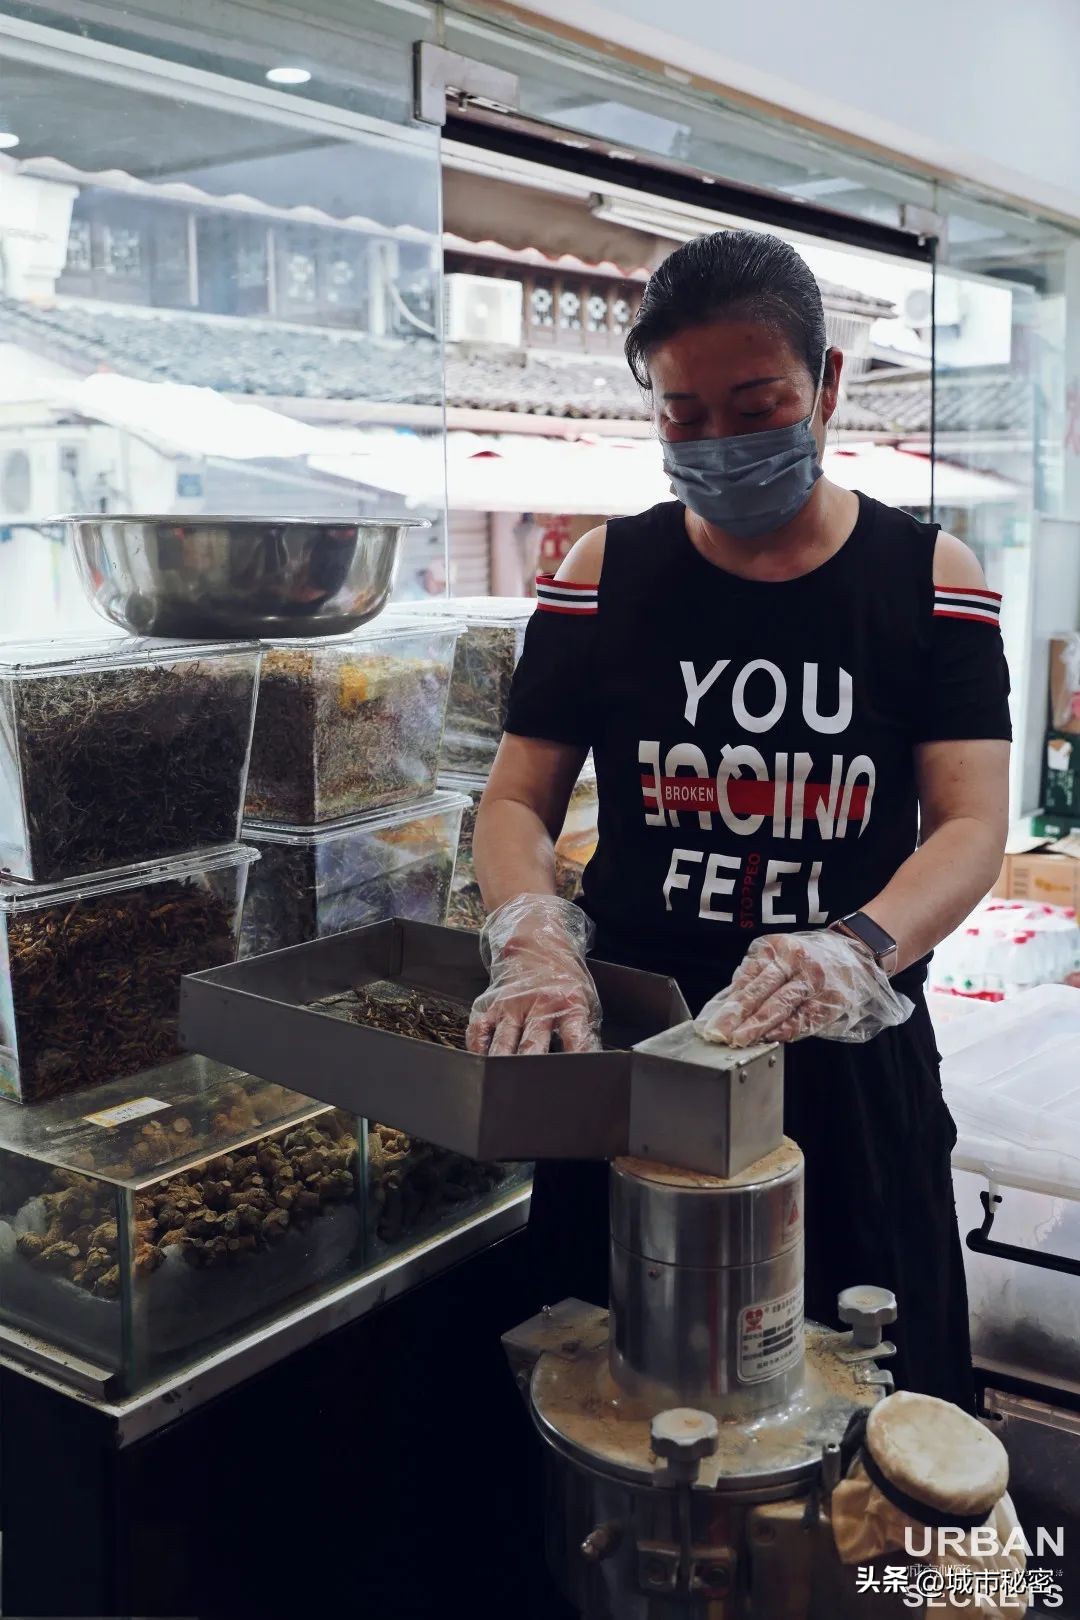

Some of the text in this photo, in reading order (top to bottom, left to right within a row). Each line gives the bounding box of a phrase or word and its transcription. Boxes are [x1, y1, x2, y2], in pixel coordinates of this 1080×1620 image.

[679, 658, 853, 735] YOU
[665, 786, 714, 803] BROKEN
[663, 848, 829, 924] FEEL
